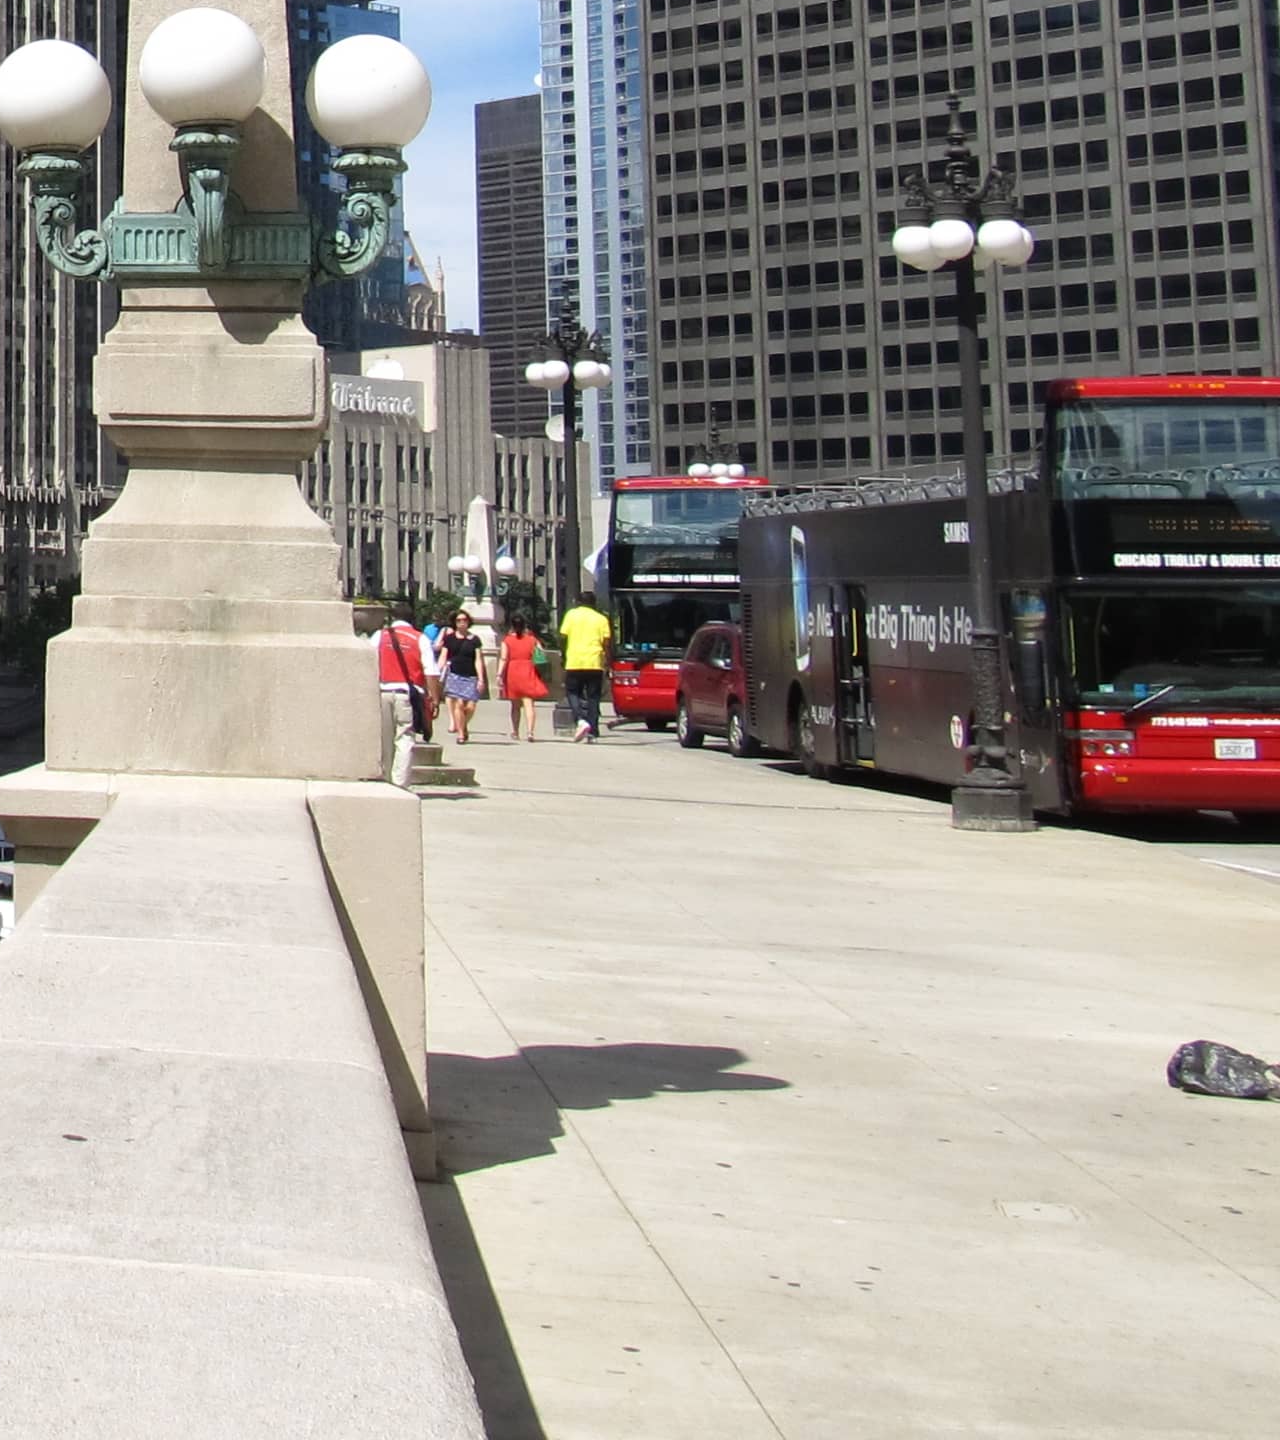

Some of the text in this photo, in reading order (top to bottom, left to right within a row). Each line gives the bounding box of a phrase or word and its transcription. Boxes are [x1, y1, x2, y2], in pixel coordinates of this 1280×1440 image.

[332, 382, 416, 415] Tribune
[944, 522, 970, 543] SAMS
[1114, 553, 1161, 567] CHICAGO
[1163, 553, 1208, 567] TROLLEY
[1210, 554, 1220, 567] &
[1221, 554, 1263, 567] DOUBLE
[879, 604, 899, 649] Big
[900, 605, 937, 652] Thing
[939, 606, 951, 644] Is
[954, 606, 973, 646] He
